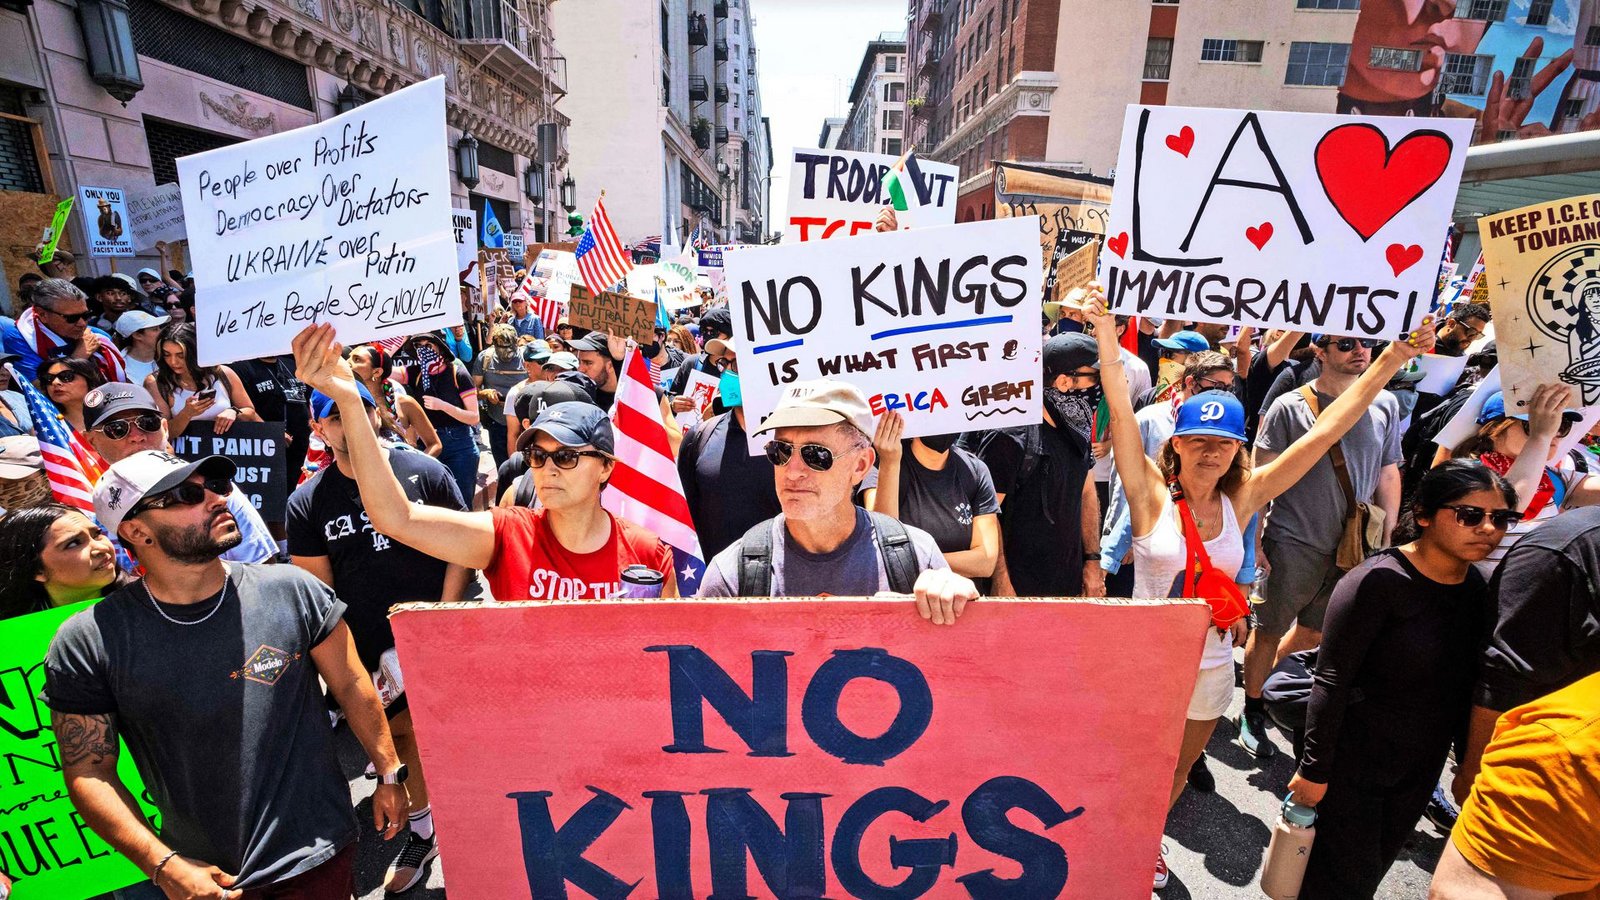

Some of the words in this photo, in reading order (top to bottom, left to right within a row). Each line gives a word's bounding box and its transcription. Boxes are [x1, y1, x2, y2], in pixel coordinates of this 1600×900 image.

[200, 160, 257, 200] People
[266, 157, 301, 180] over
[314, 120, 378, 167] Profits
[105, 191, 120, 201] YOU
[795, 153, 894, 205] TROOP
[1132, 108, 1315, 267] LA
[216, 194, 318, 235] Democracy
[322, 174, 361, 207] Over
[338, 178, 429, 226] Dictators
[1071, 236, 1086, 244] was
[1489, 210, 1542, 239] KEEP
[227, 236, 333, 282] UKRAINE
[339, 232, 379, 259] over
[366, 243, 415, 278] Putin
[216, 312, 238, 337] We
[242, 301, 275, 330] The
[284, 285, 343, 325] People
[348, 283, 378, 320] Say
[378, 277, 450, 324] ENOUGH
[572, 286, 588, 300] I
[594, 292, 630, 312] HATE
[635, 301, 647, 316] A
[741, 276, 823, 342] NO
[850, 255, 1028, 326] KINGS
[1107, 266, 1418, 341] IMMIGRANTS!
[632, 316, 655, 330] ASS
[768, 358, 800, 386] IS
[817, 348, 898, 377] WHAT
[912, 341, 989, 371] FIRST
[868, 388, 949, 417] ERICA
[961, 380, 1034, 407] GREAT
[1199, 401, 1225, 422] D
[172, 435, 202, 454] N'T
[212, 437, 276, 457] PANIC
[234, 467, 271, 483] UST
[371, 531, 391, 552] LA
[529, 568, 587, 600] STOP
[253, 658, 283, 673] Modelo
[645, 645, 934, 766] NO
[506, 776, 1085, 900] KINGS
